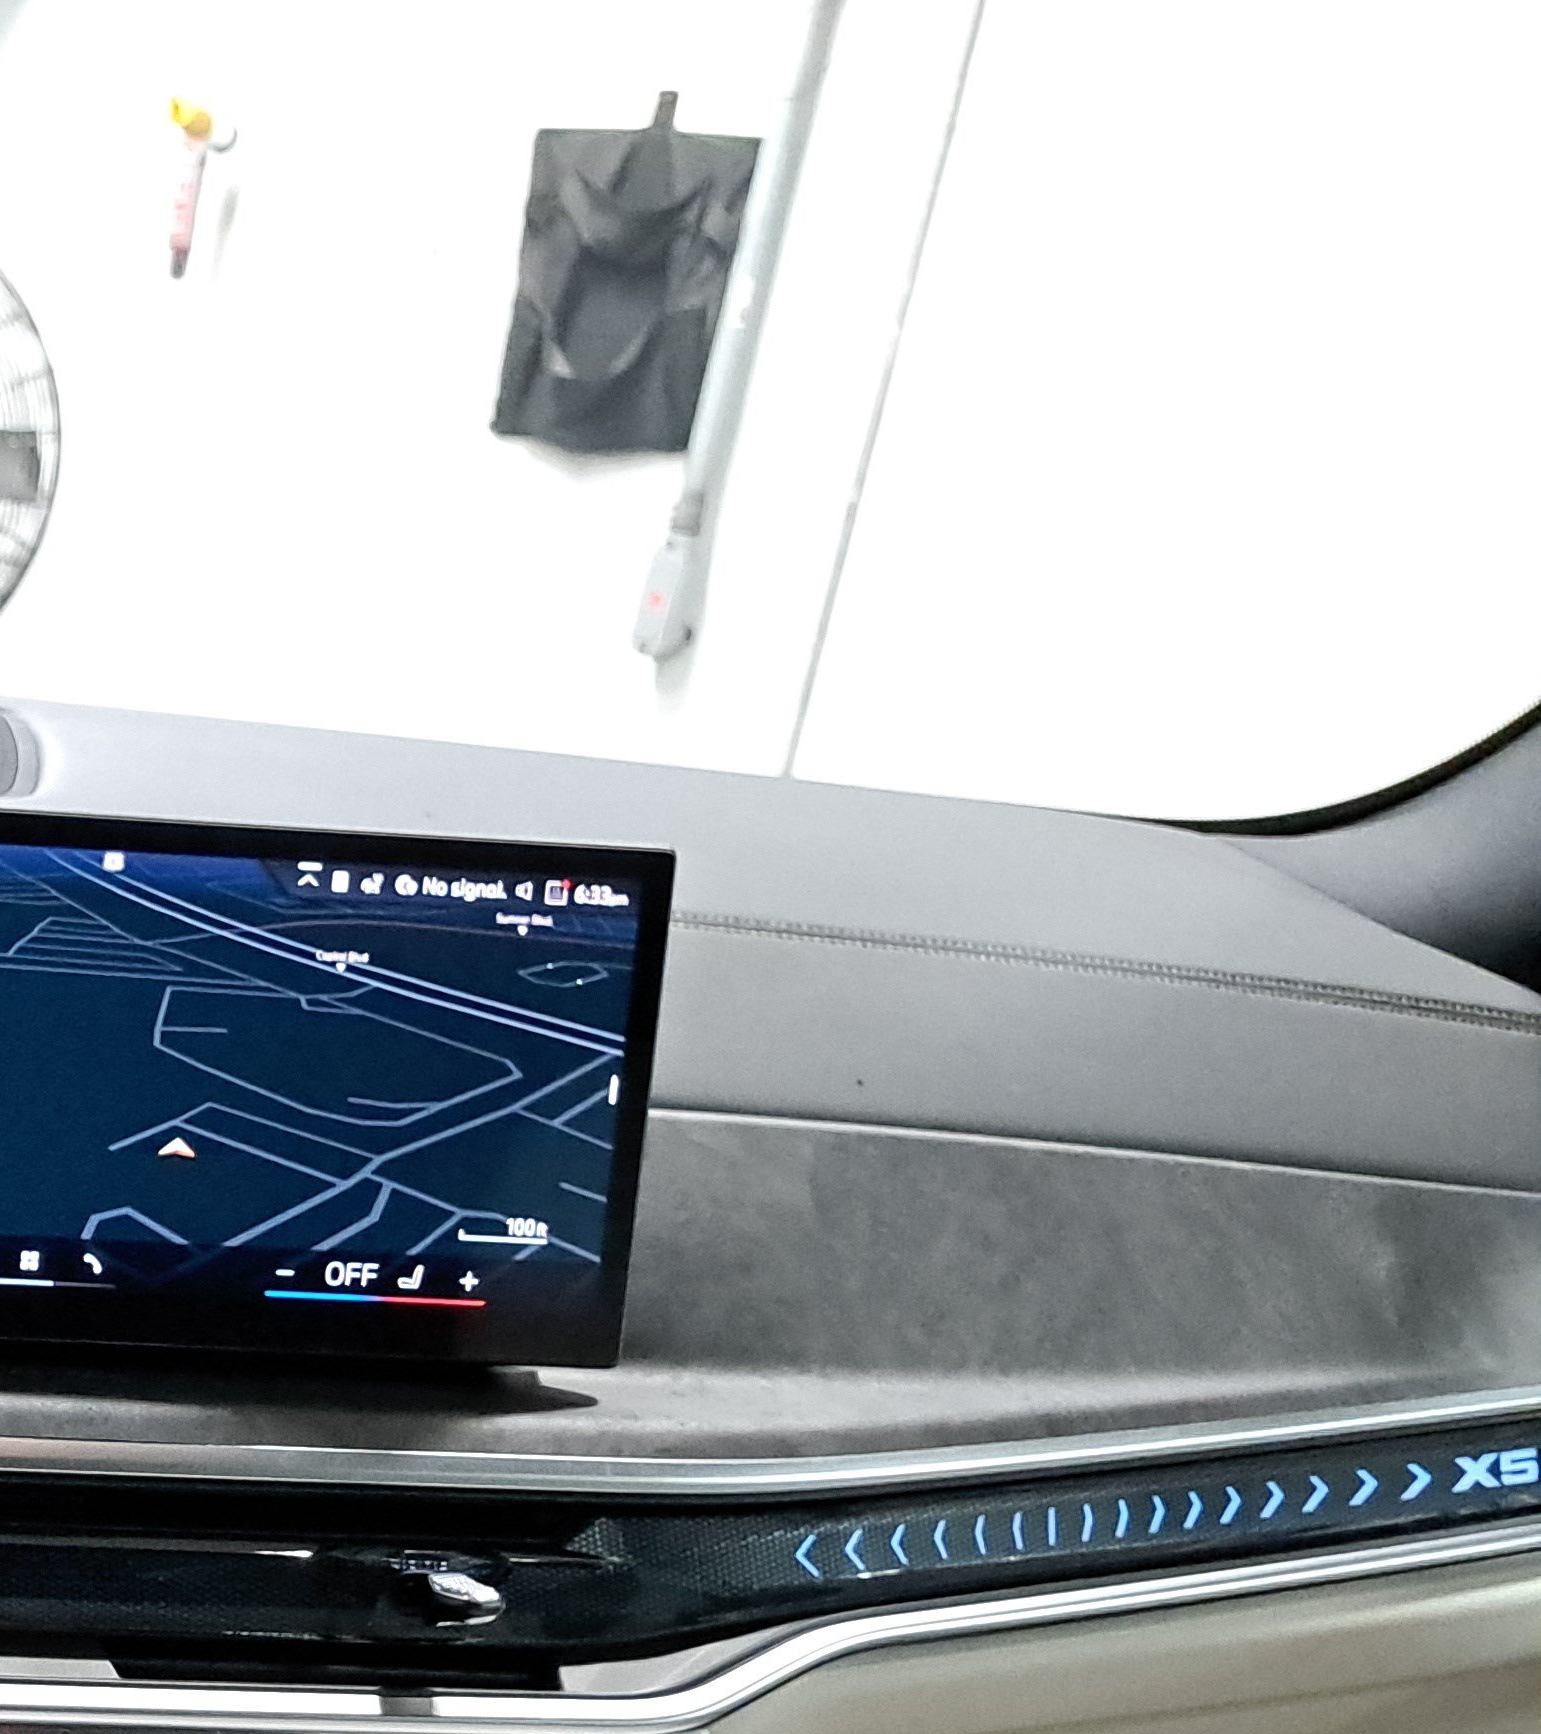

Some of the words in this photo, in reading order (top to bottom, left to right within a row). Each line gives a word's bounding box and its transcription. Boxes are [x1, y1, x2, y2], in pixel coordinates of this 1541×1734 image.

[422, 876, 449, 897] No
[324, 1261, 381, 1288] OFF
[1451, 1447, 1540, 1493] X5
